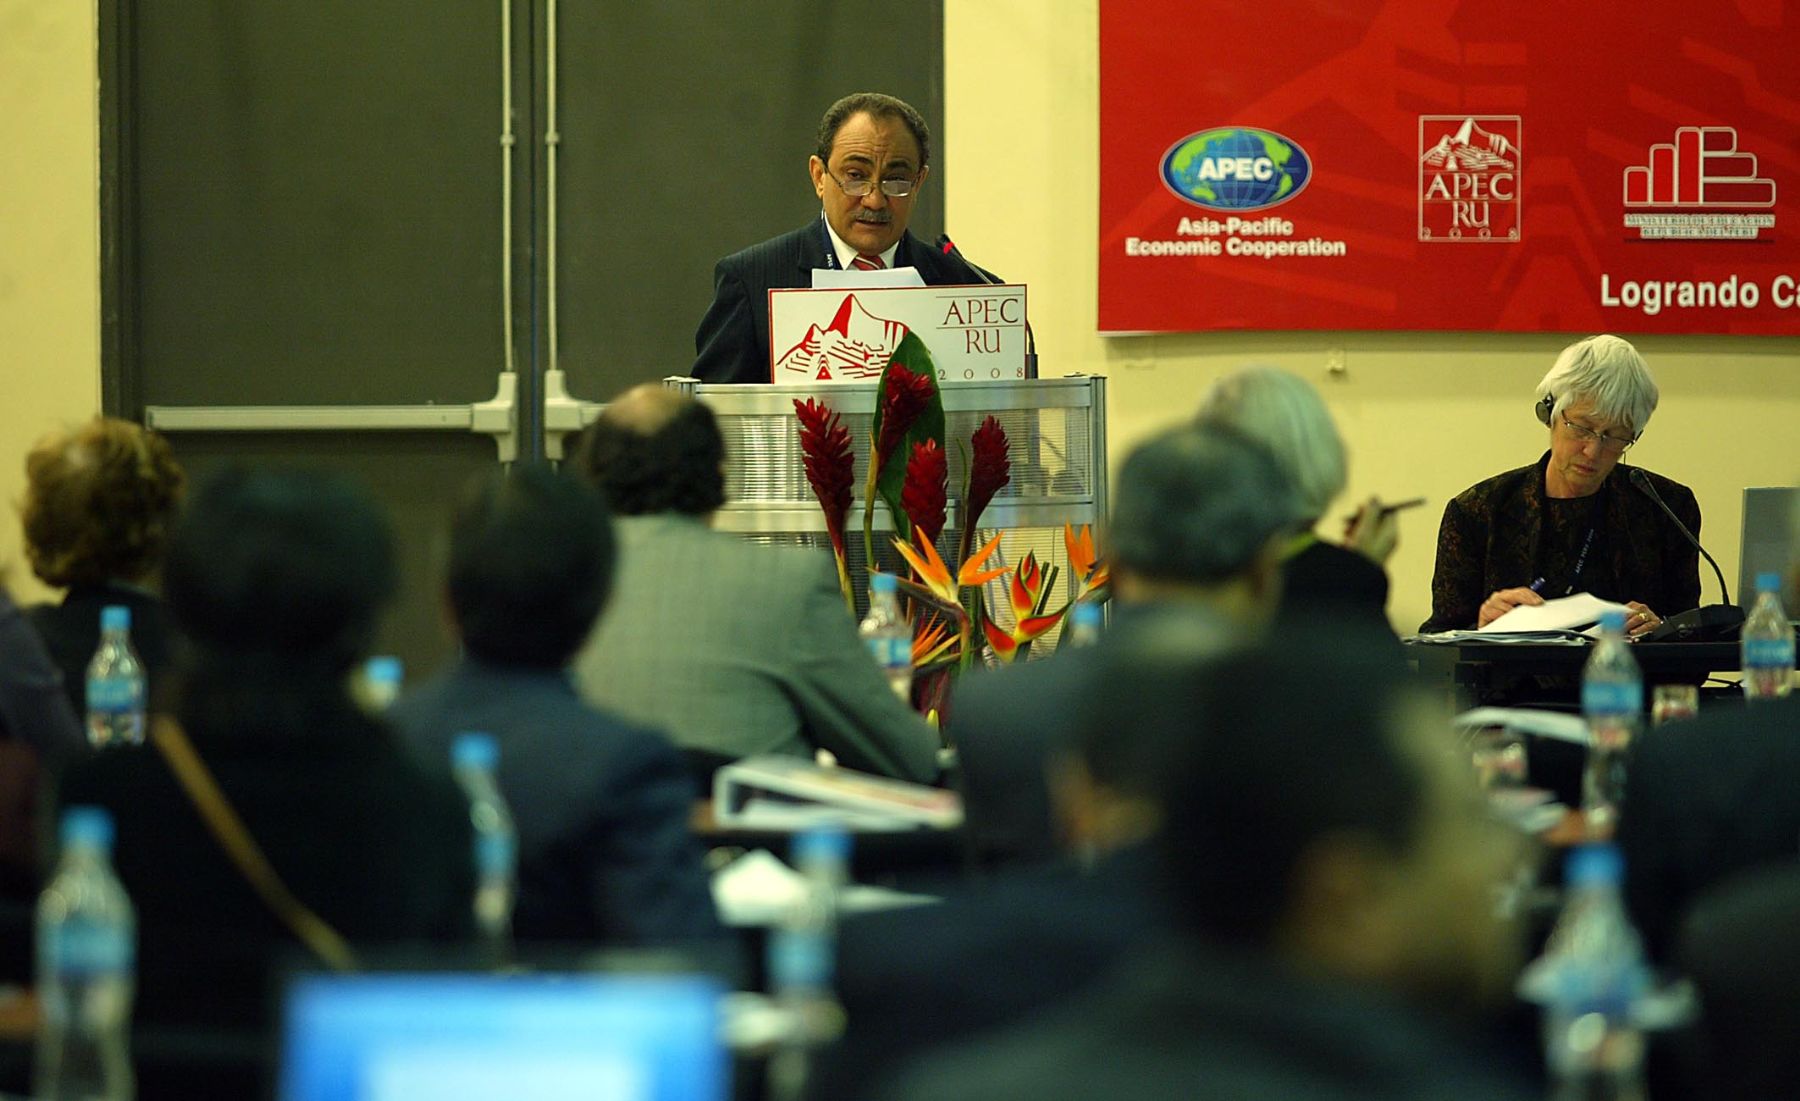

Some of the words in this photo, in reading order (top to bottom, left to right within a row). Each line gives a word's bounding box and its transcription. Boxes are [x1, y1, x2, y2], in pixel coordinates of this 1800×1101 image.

[1198, 157, 1274, 181] APEC
[1425, 173, 1514, 200] APEC
[1177, 217, 1294, 236] Asia-Pacific
[1452, 201, 1490, 228] RU
[1125, 237, 1222, 257] Economic
[1225, 237, 1347, 260] Cooperation
[1601, 273, 1760, 316] Logrando
[1771, 274, 1800, 308] C
[942, 298, 1019, 326] APEC
[965, 329, 1001, 354] RU
